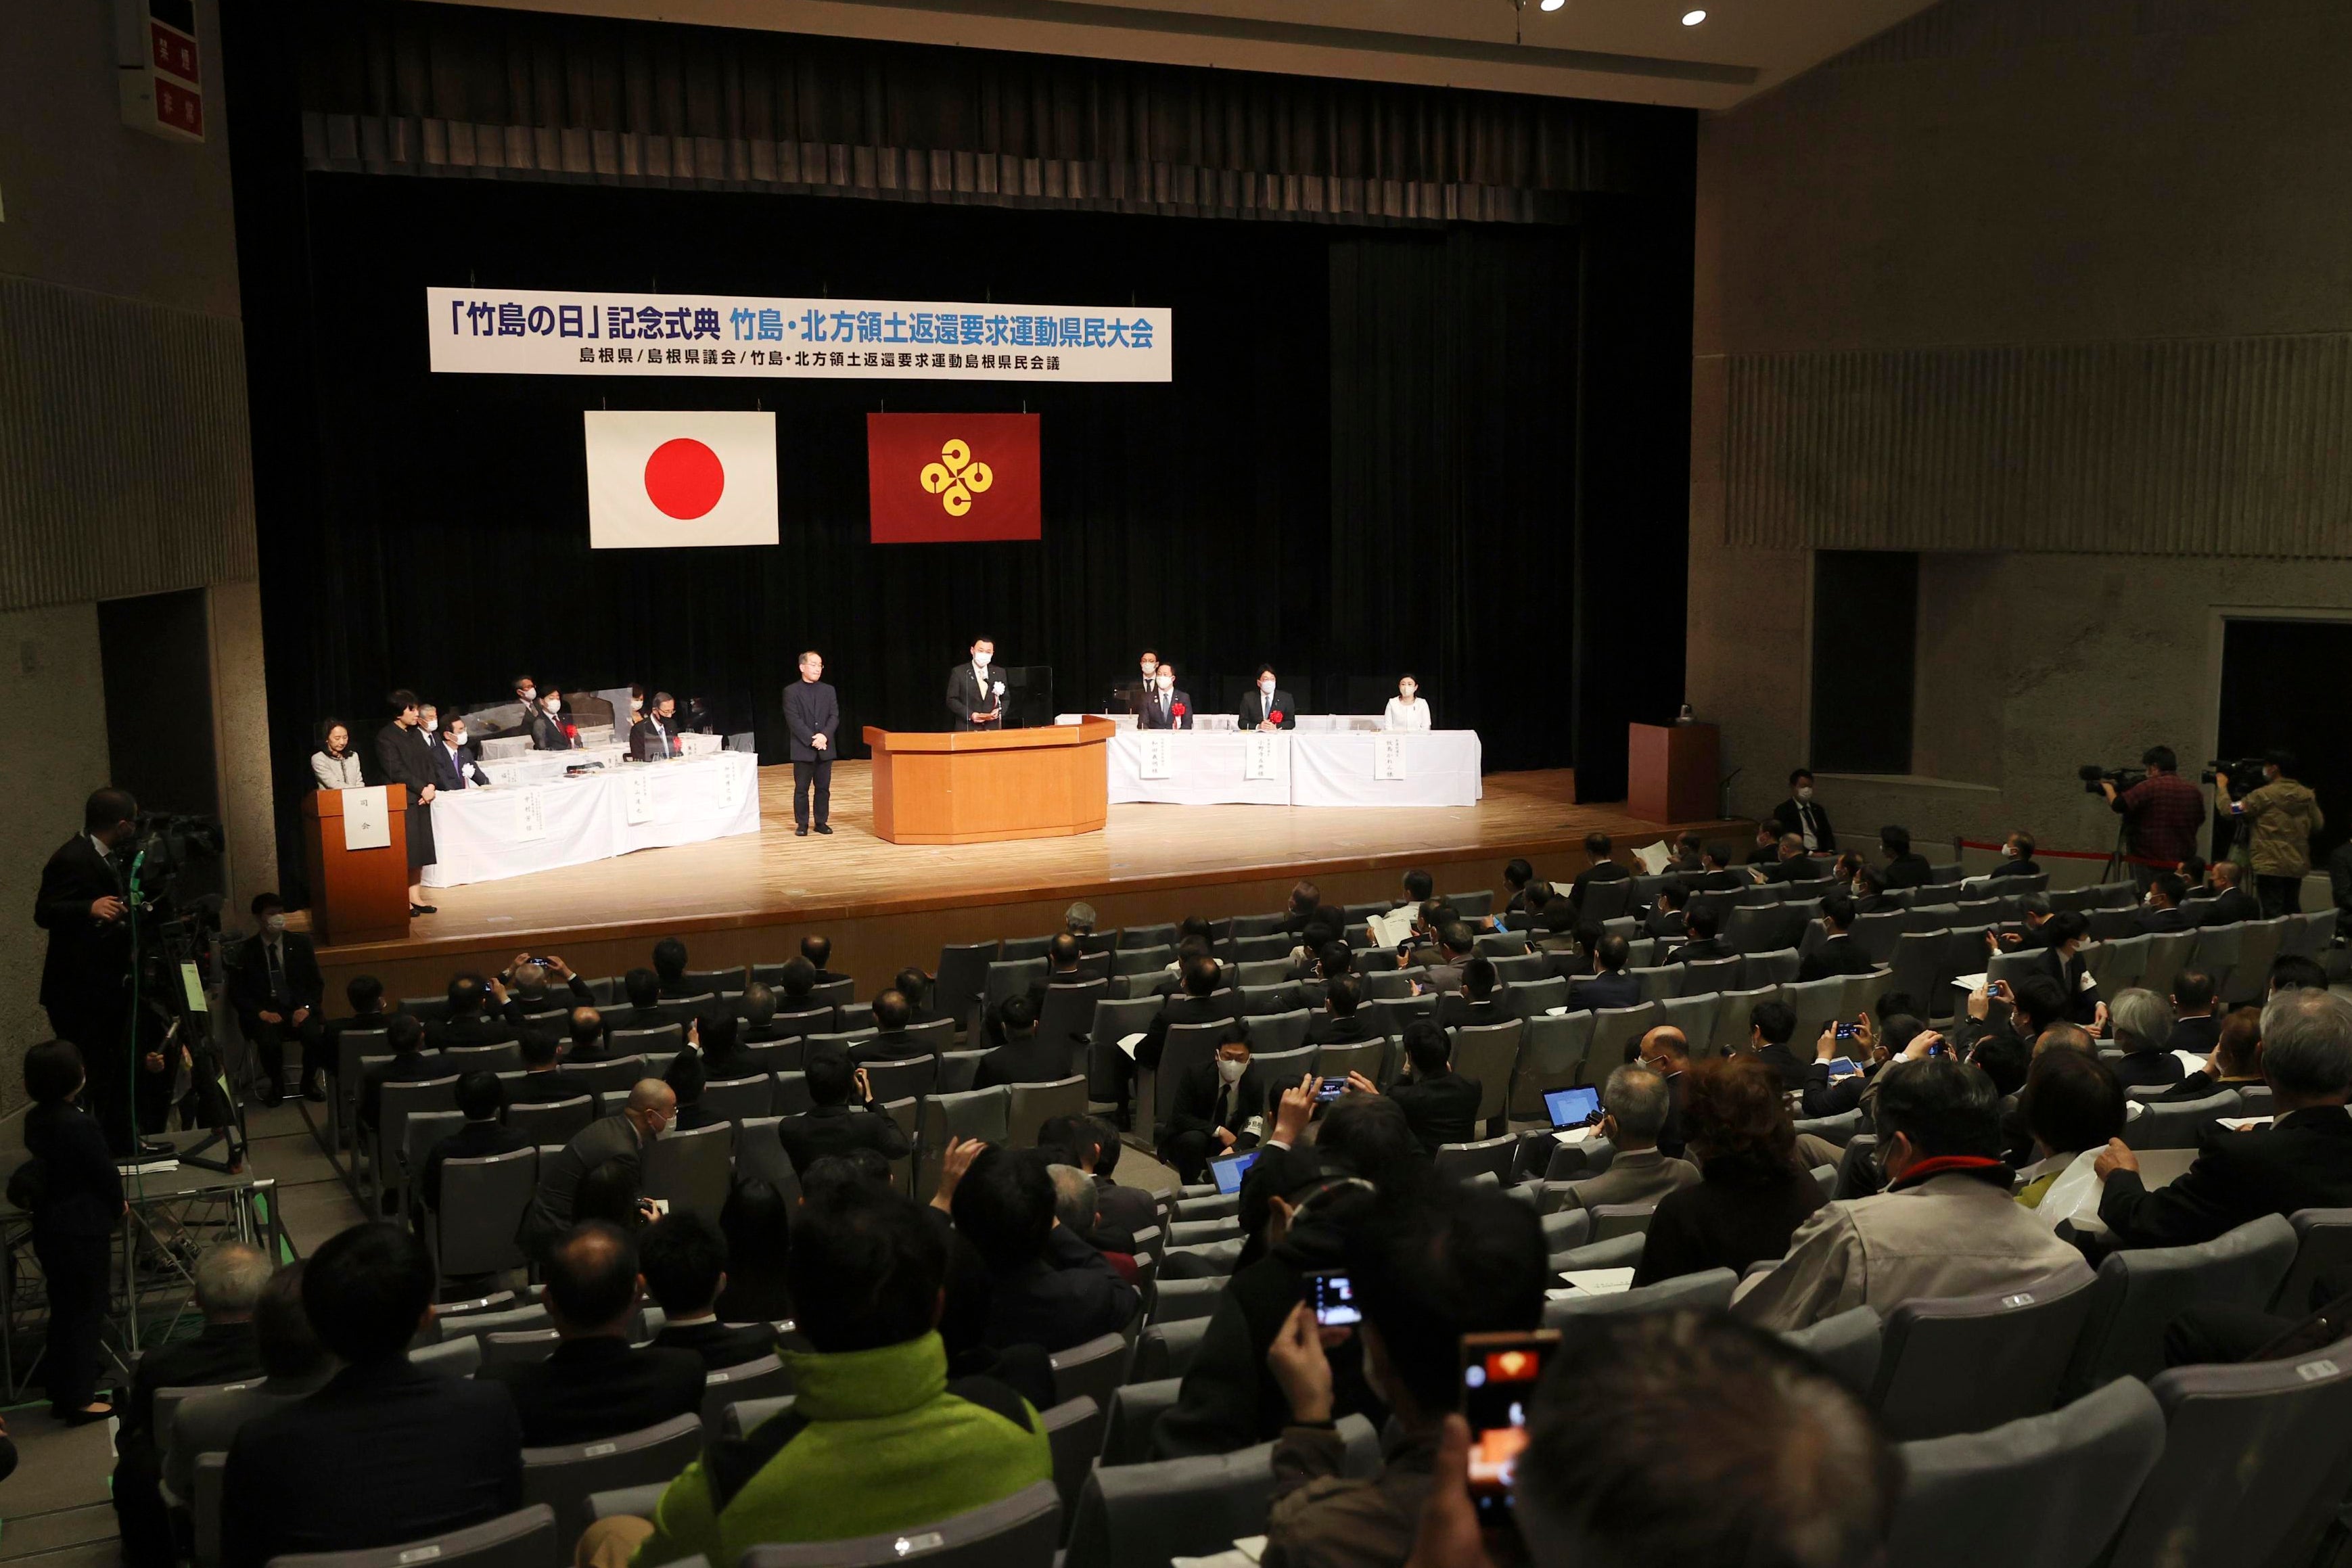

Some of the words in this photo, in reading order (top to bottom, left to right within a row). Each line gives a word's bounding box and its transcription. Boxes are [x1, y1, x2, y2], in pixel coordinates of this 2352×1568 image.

[452, 300, 720, 341] 「竹島の日」記念式典
[729, 307, 1153, 349] 竹島・北方領土返還要求運動県民大会
[360, 799, 371, 830] 司会
